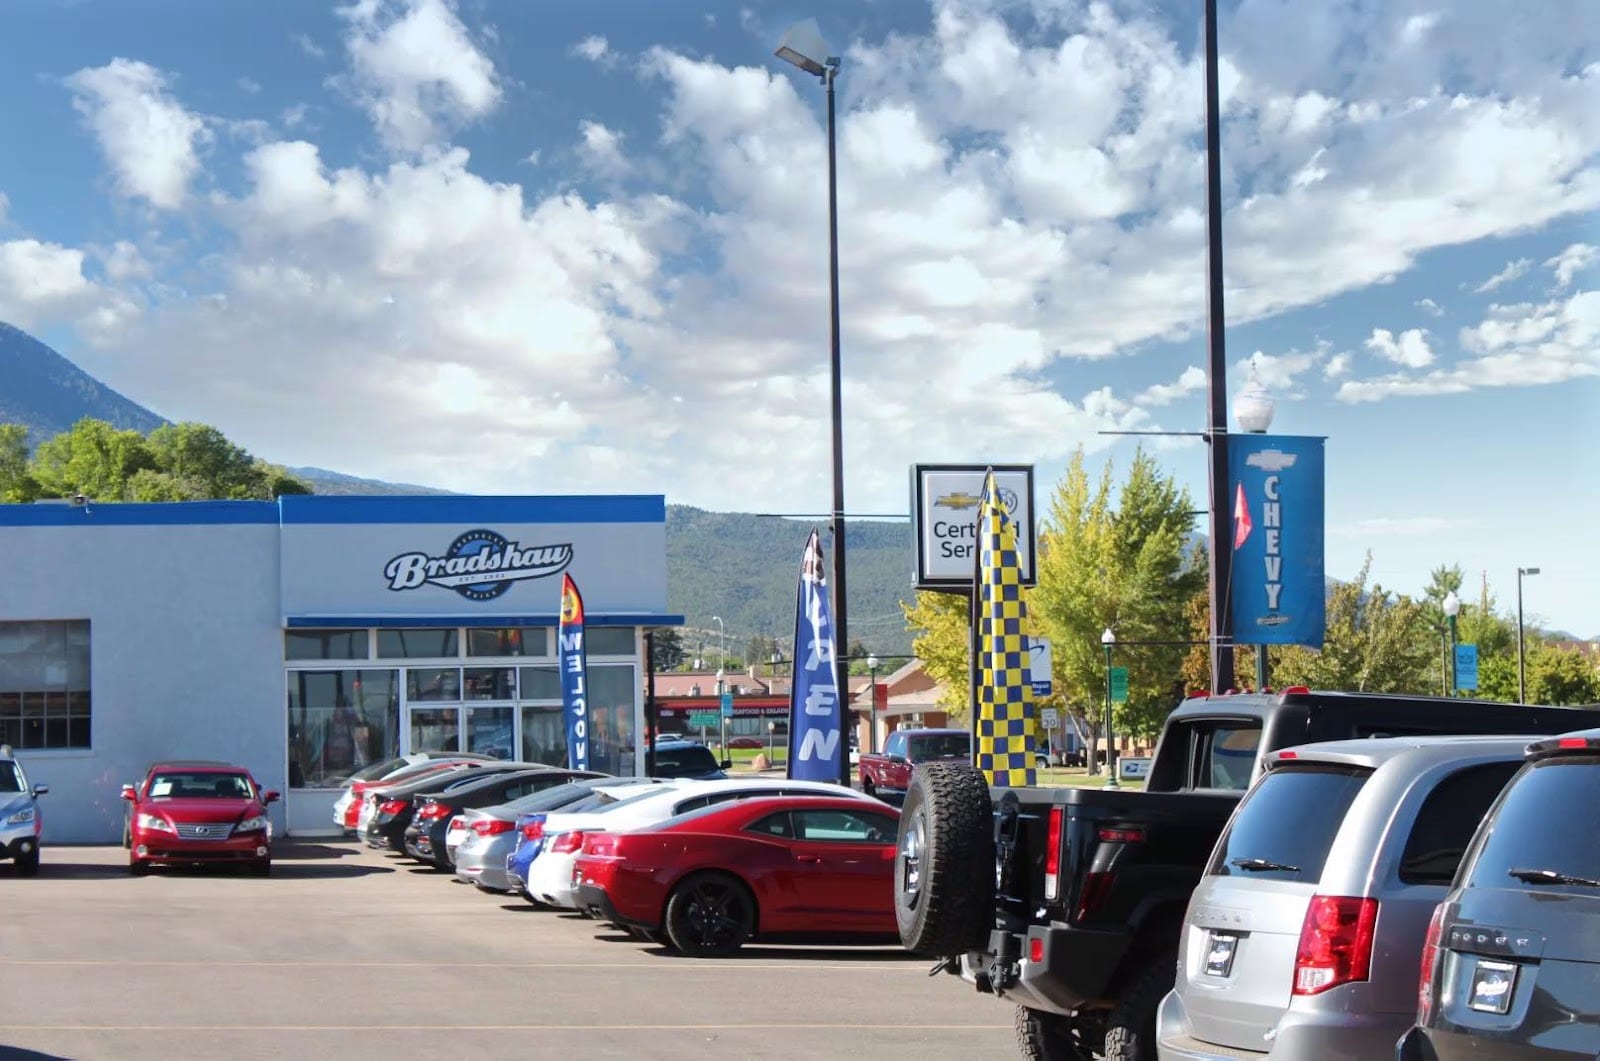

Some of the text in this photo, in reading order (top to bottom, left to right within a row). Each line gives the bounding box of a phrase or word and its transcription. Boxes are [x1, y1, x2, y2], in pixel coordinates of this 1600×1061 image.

[933, 520, 1020, 538] Certd
[1263, 475, 1281, 609] CHEVY
[384, 541, 573, 591] Bradshaw
